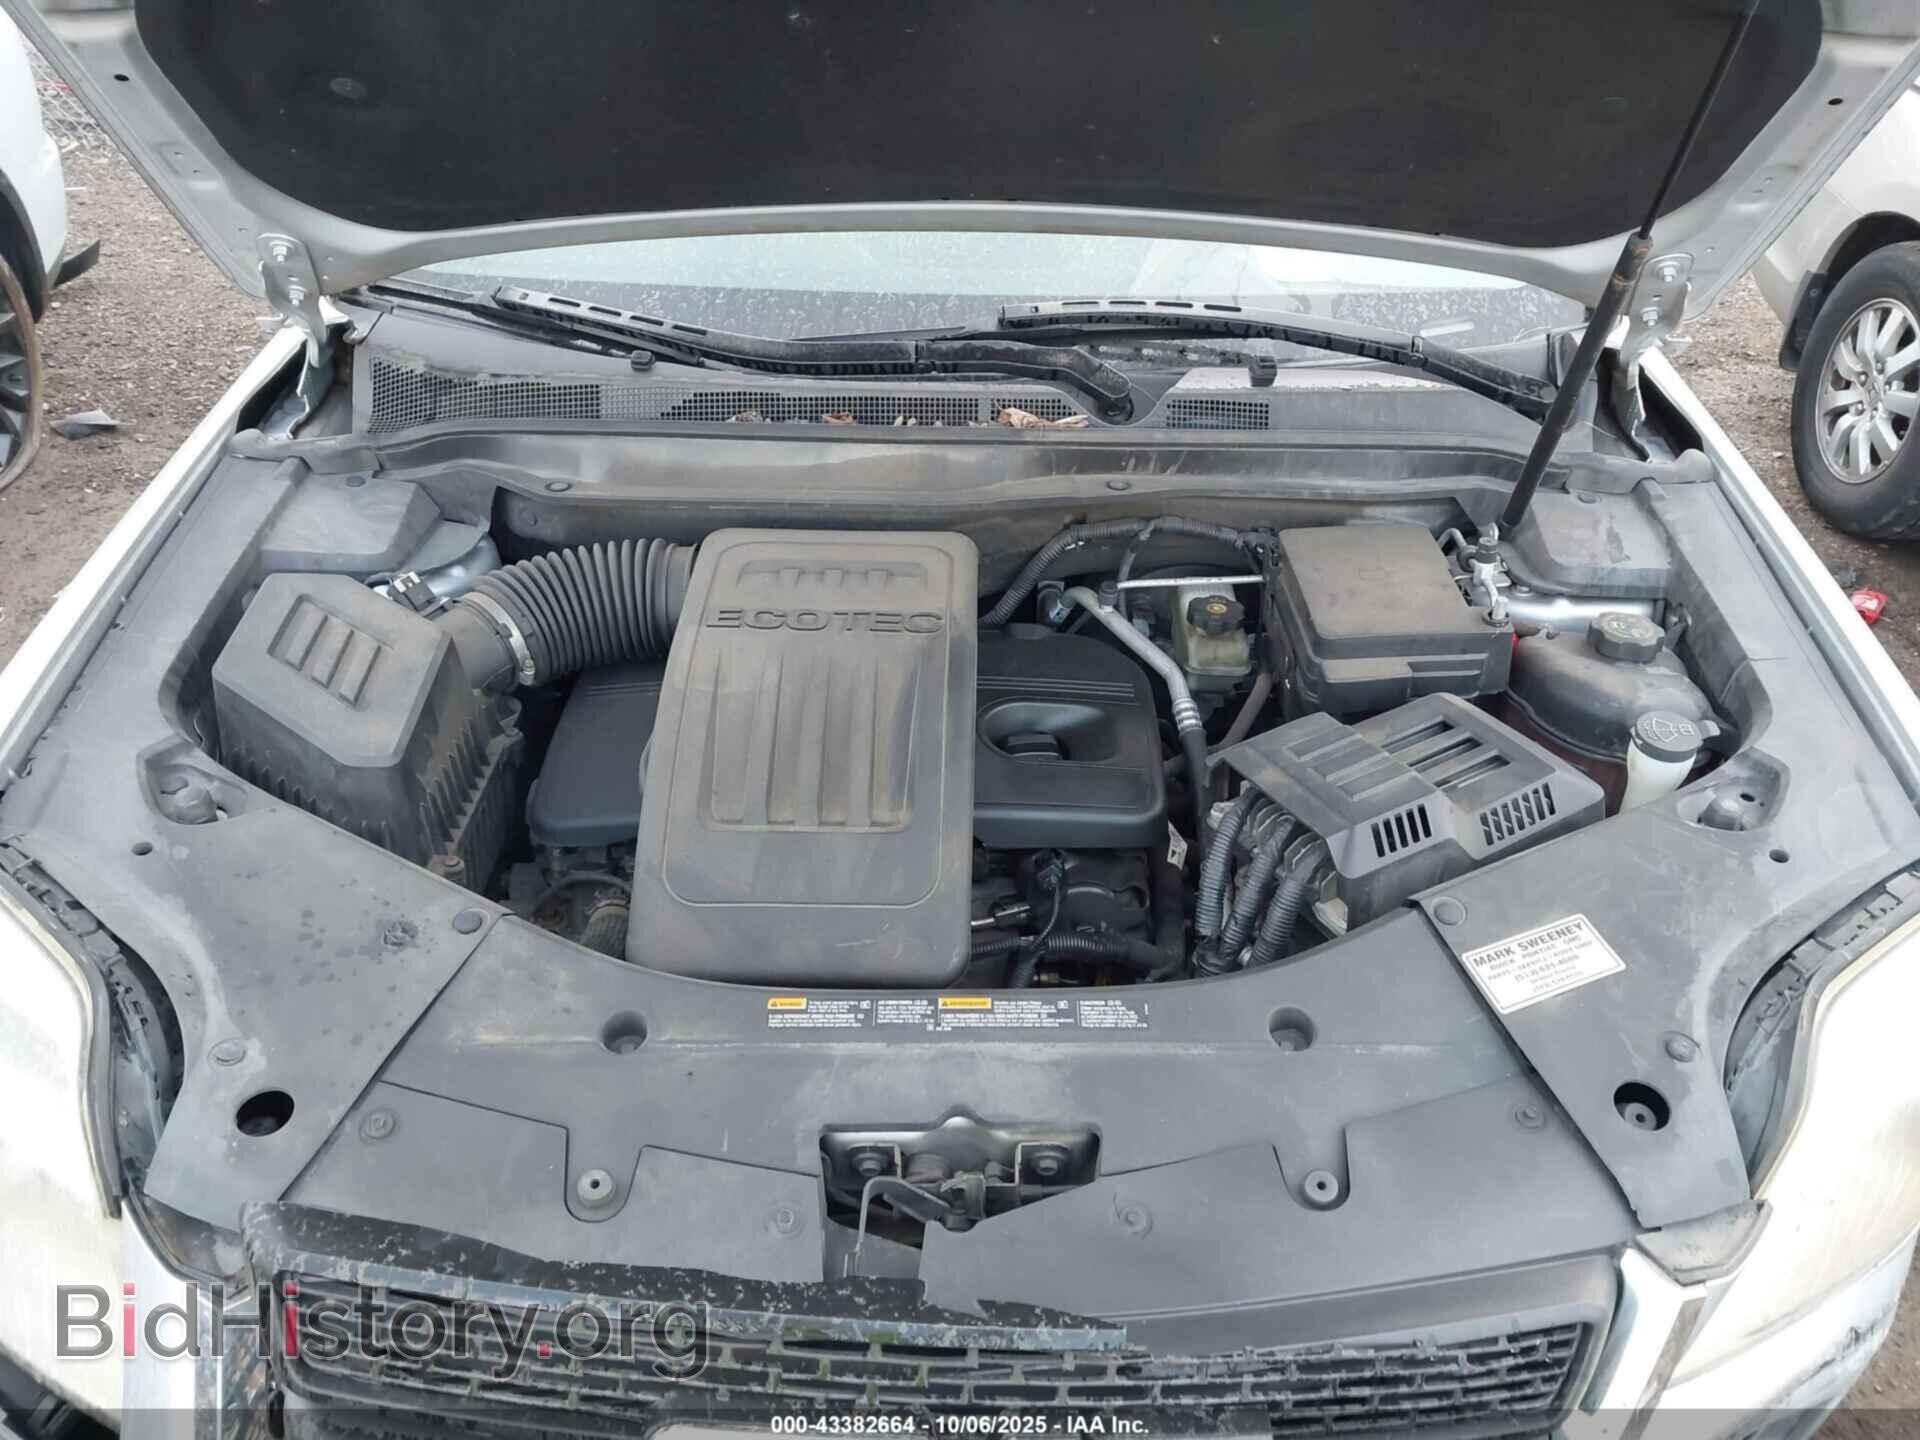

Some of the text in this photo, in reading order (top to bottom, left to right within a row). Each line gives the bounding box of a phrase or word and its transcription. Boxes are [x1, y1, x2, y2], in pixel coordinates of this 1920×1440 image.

[705, 609, 943, 634] ECOTEC
[1473, 946, 1516, 968] MARK
[1517, 922, 1584, 952] SWEENEY
